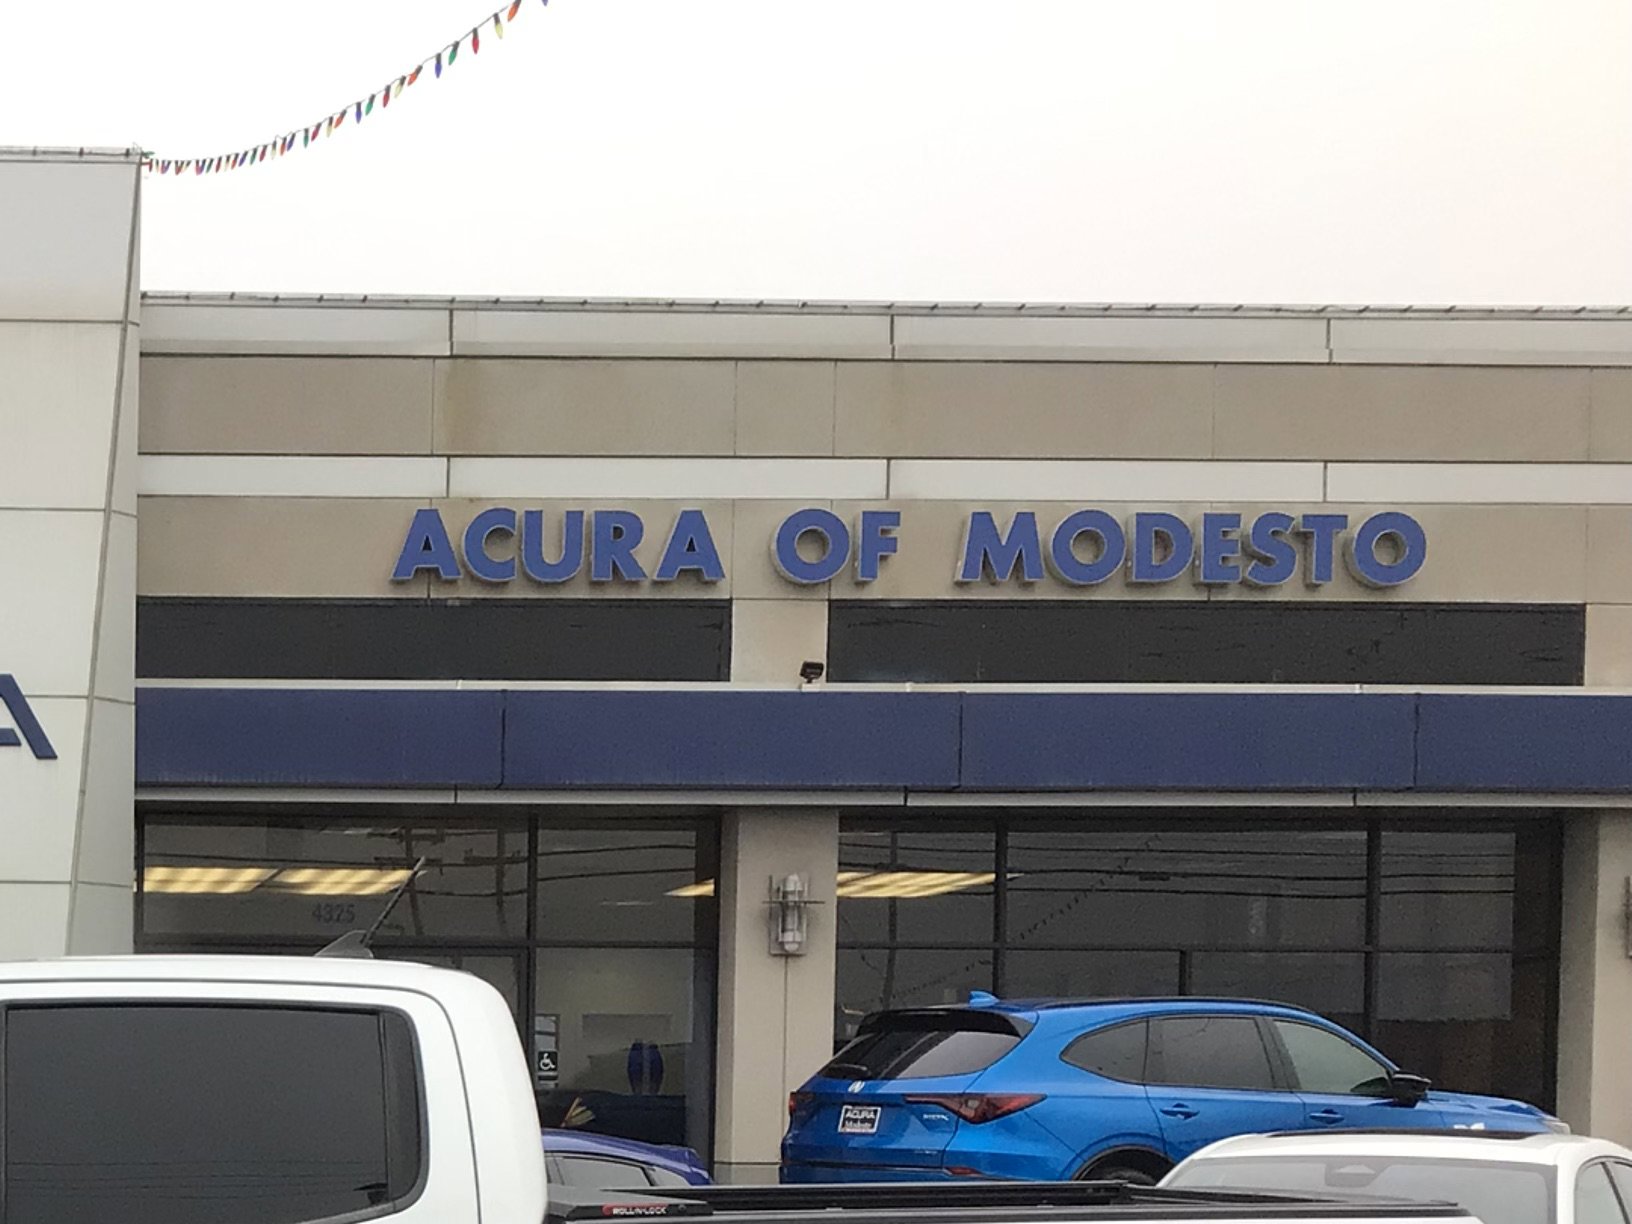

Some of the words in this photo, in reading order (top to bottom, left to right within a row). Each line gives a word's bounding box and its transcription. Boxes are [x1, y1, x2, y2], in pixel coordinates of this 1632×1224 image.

[392, 507, 727, 583] ACURA
[770, 507, 901, 585] OF
[954, 509, 1428, 589] MODESTO
[845, 1110, 876, 1119] ACURA
